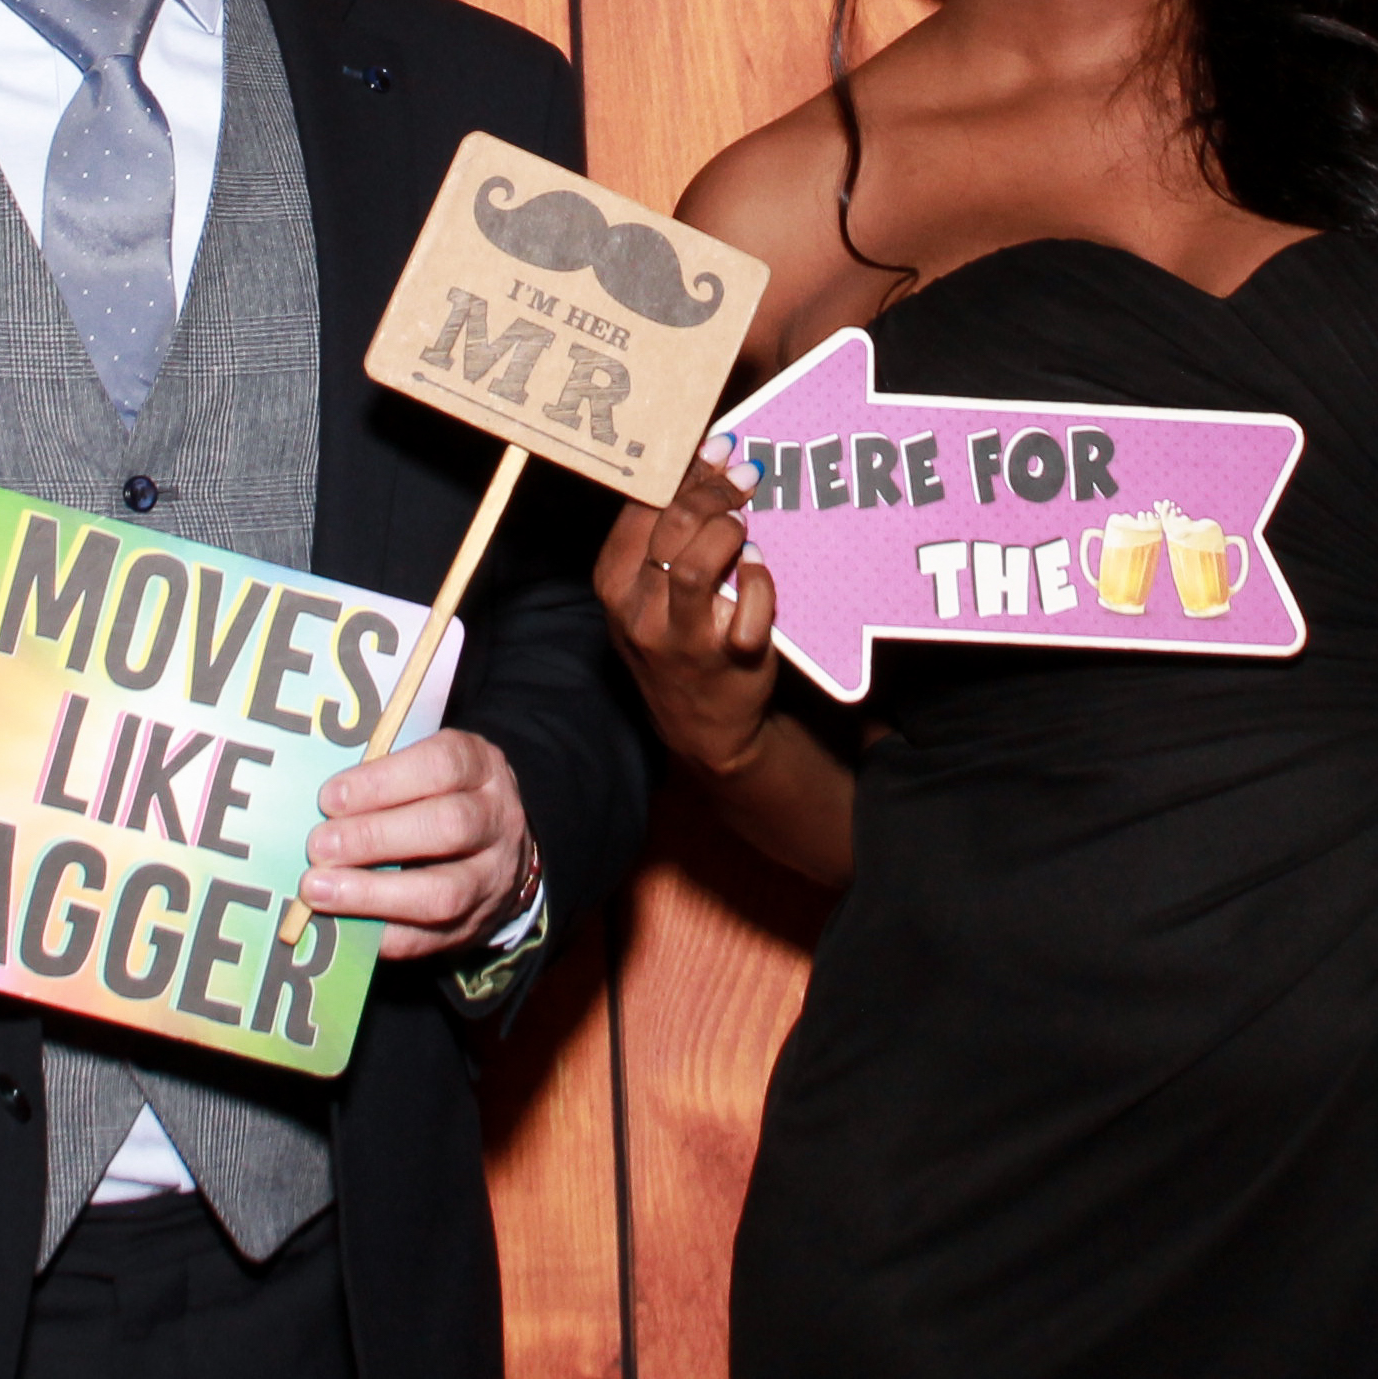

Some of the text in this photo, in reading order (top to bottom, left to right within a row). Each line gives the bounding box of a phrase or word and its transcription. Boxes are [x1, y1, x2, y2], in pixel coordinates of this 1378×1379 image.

[507, 279, 632, 352] I'M HER
[419, 286, 645, 458] MR.
[743, 425, 1119, 513] HERE FOR
[917, 538, 1079, 619] THE
[33, 689, 276, 861] LIKE
